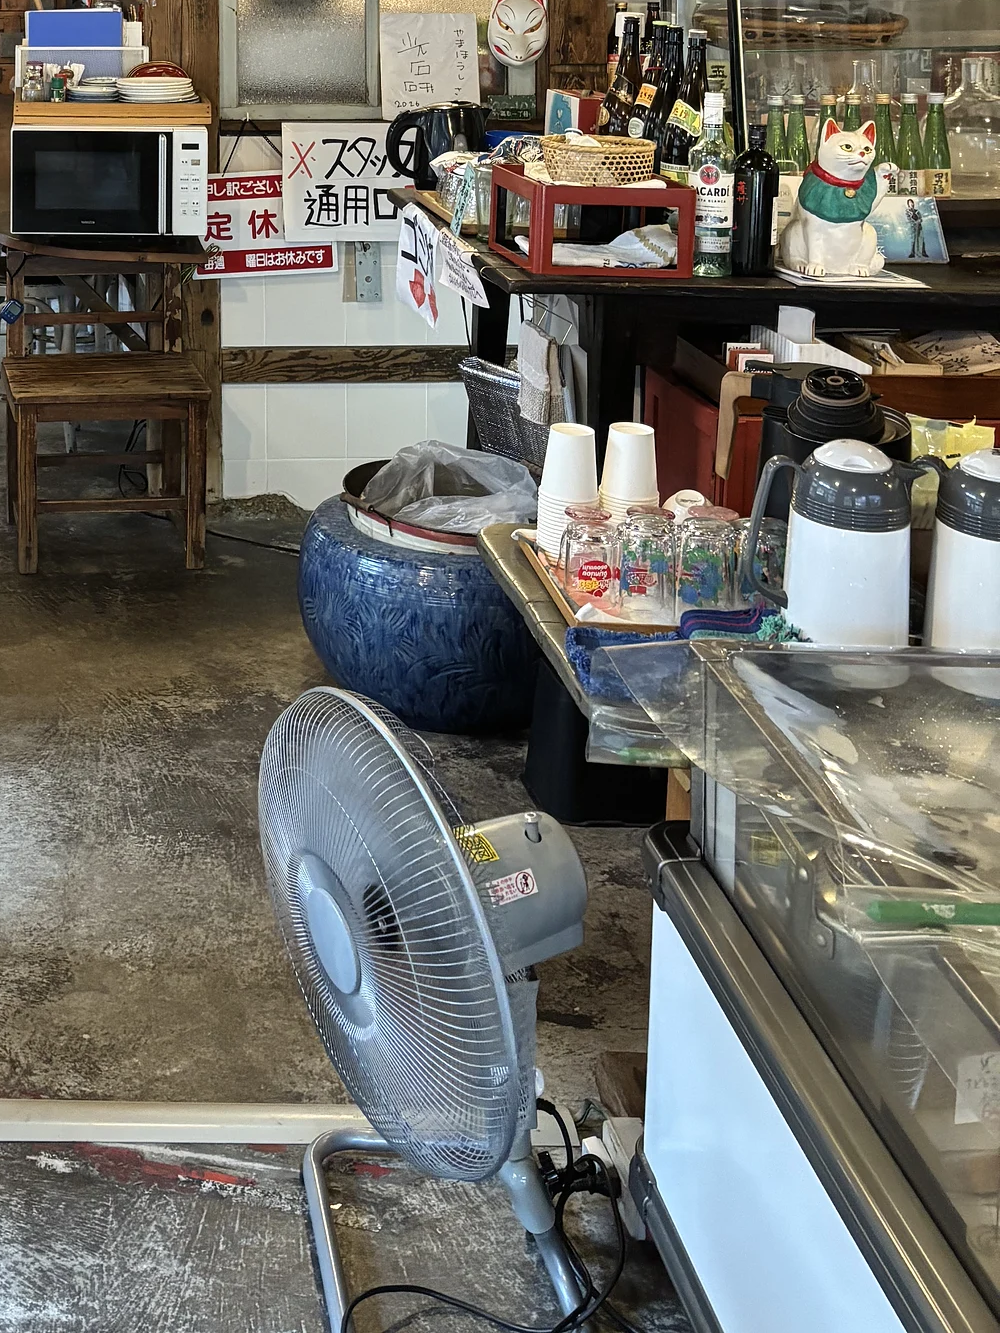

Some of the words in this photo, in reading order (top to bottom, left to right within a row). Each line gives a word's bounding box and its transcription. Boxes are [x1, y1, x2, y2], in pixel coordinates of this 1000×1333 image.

[691, 185, 730, 197] ACARDÍ
[303, 184, 397, 227] 通用口
[246, 249, 326, 268] 曜日はお休みです
